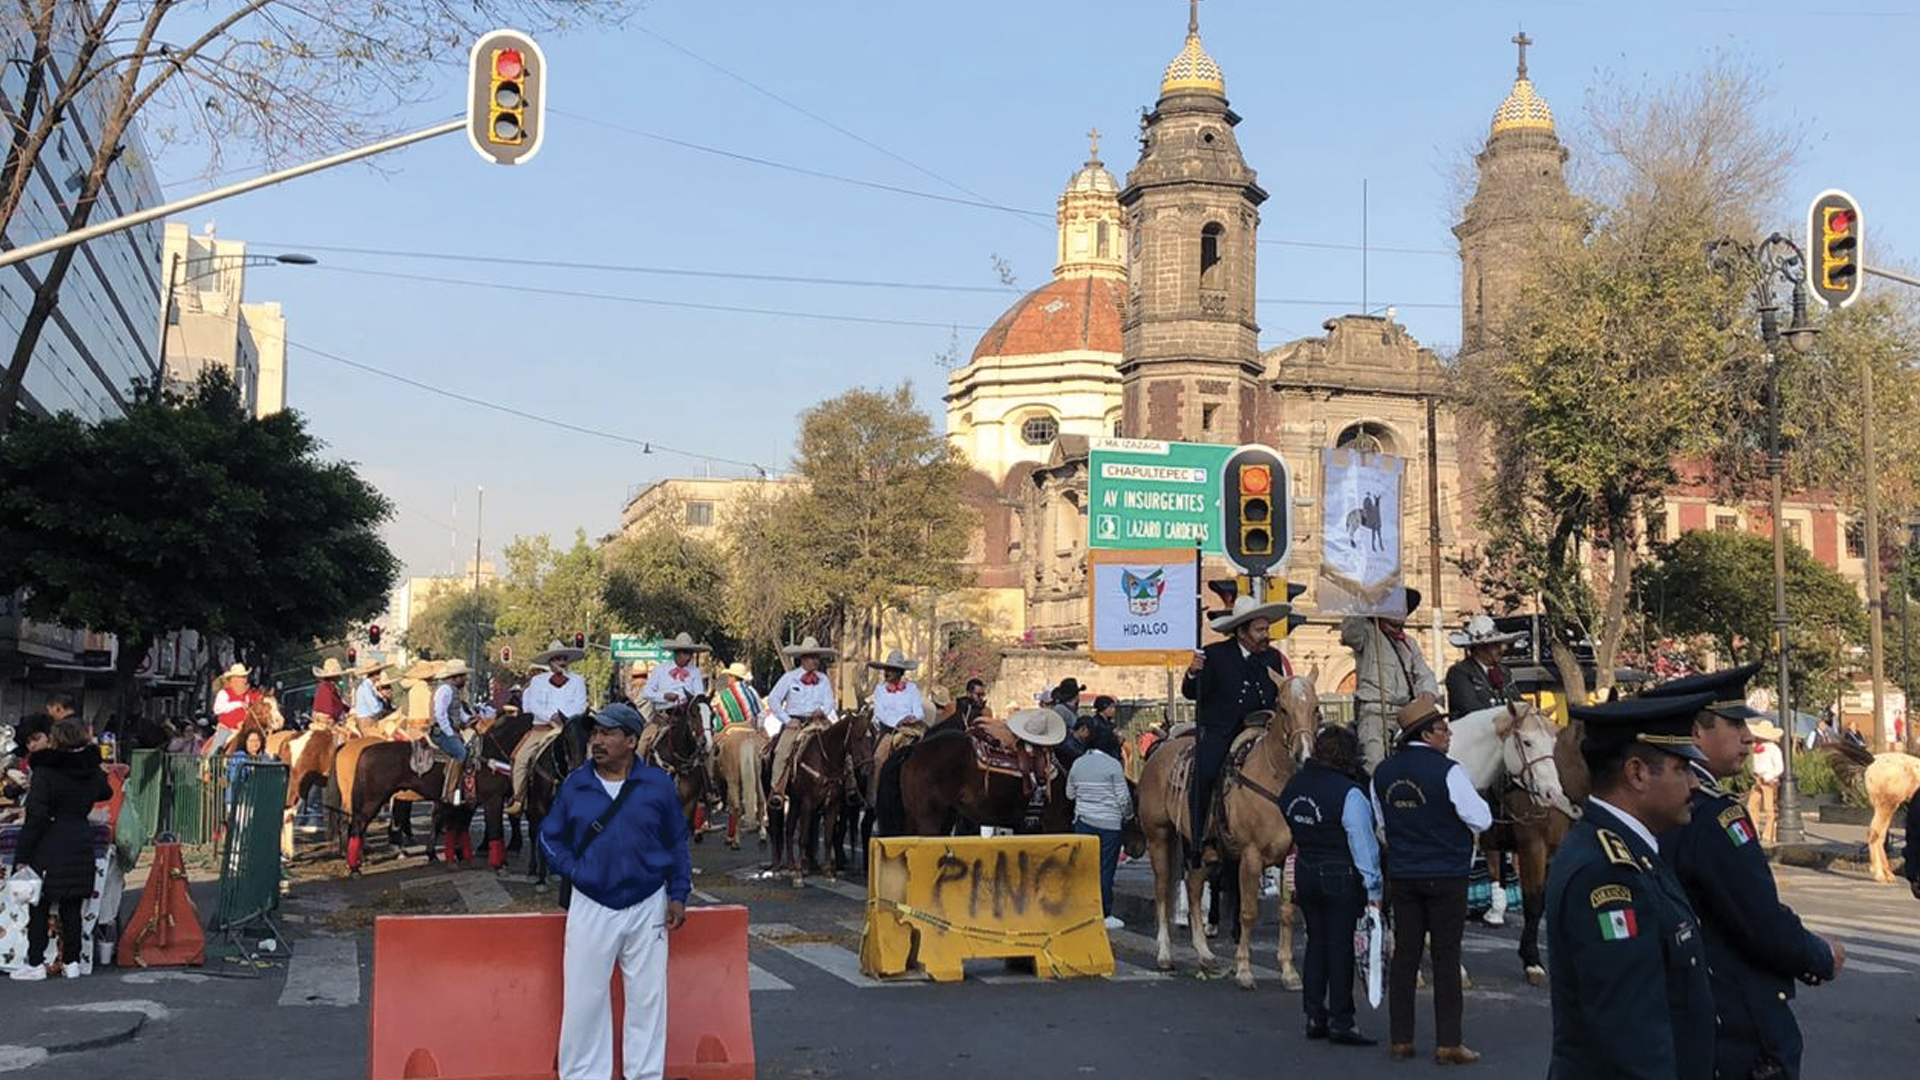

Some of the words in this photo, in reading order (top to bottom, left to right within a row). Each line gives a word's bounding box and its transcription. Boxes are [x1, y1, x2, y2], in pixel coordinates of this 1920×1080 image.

[1106, 465, 1189, 480] CHAPULTEPEC
[1103, 490, 1118, 507] AV
[1123, 491, 1204, 512] INSURGENTES
[1127, 520, 1161, 538] LAZARO
[1164, 522, 1209, 540] CARDENAS
[1123, 622, 1169, 636] HIDALGO
